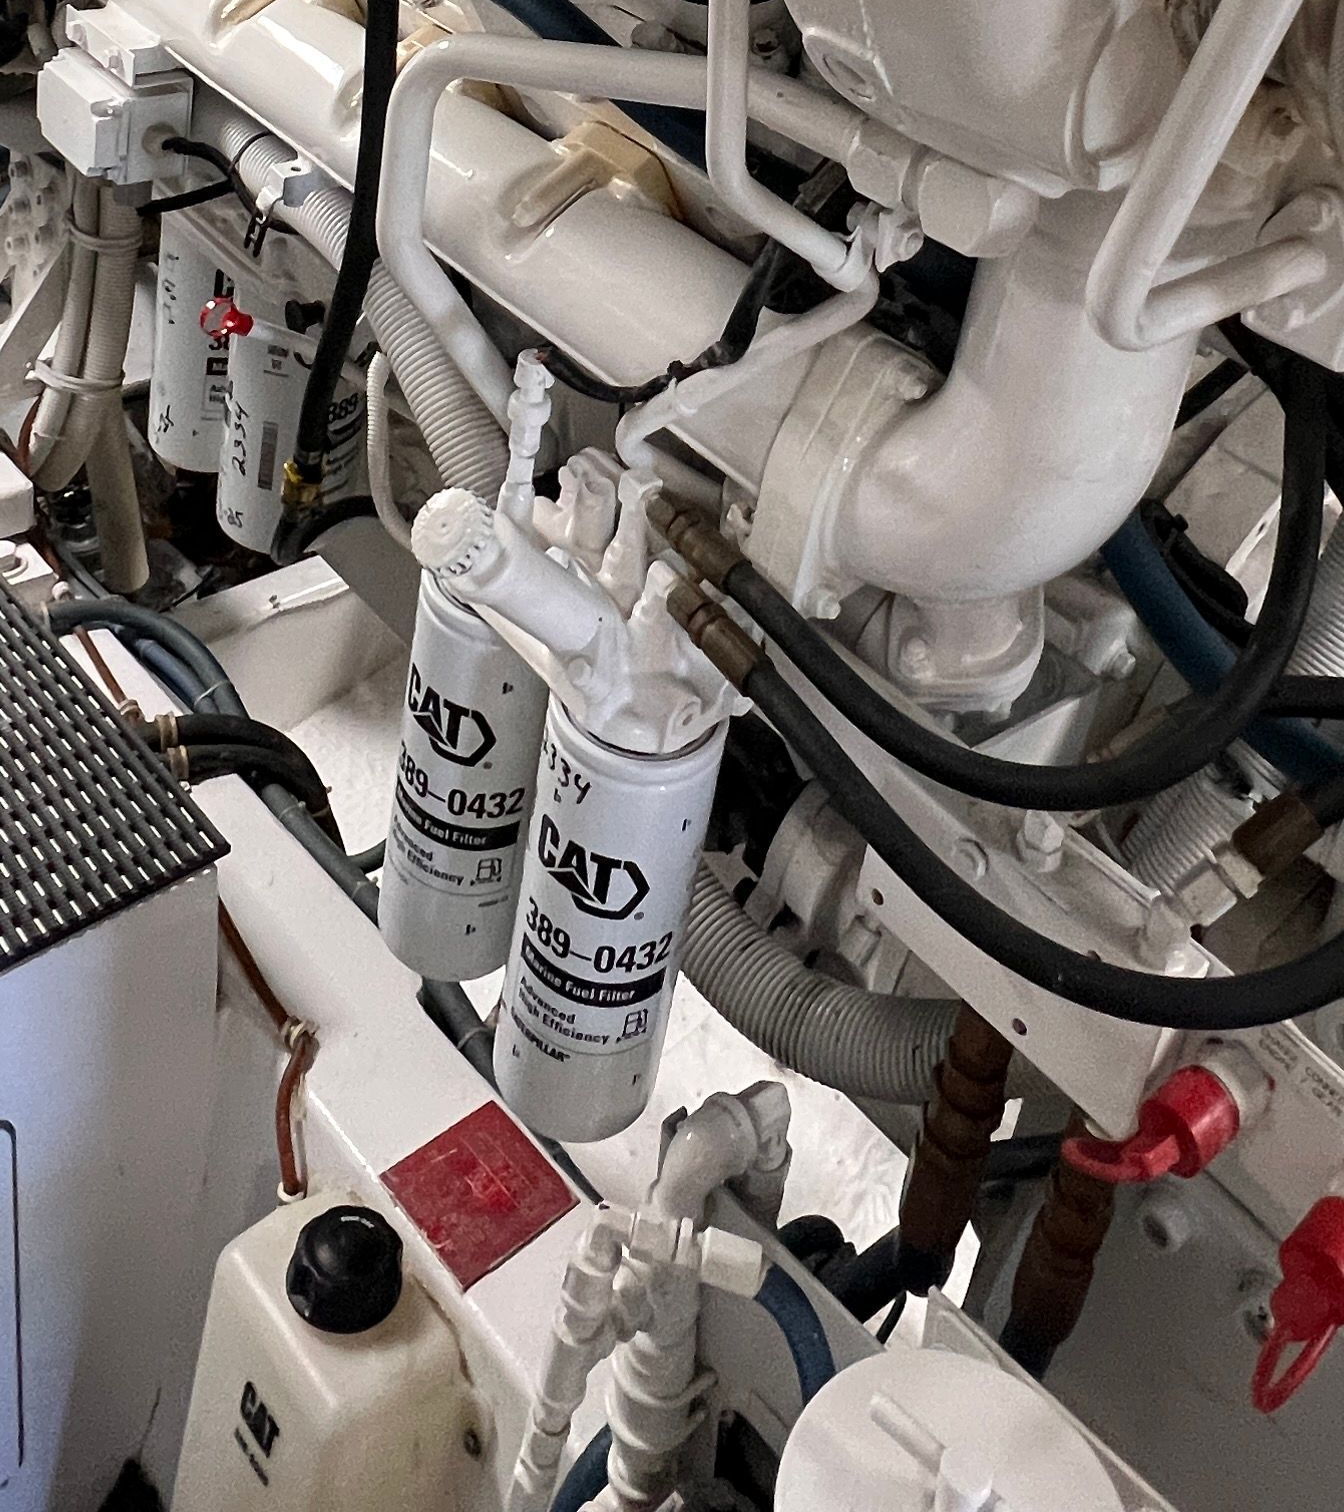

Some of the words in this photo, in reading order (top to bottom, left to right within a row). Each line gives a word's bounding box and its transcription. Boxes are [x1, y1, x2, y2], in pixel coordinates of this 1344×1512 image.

[408, 662, 476, 752] CAT
[424, 819, 450, 841] Fuel
[452, 831, 488, 846] Filter
[538, 814, 624, 906] CAT
[526, 896, 673, 974] 389-0432
[565, 980, 596, 1001] Fuel
[598, 989, 636, 1002] Filter
[542, 1013, 611, 1046] Efficiency
